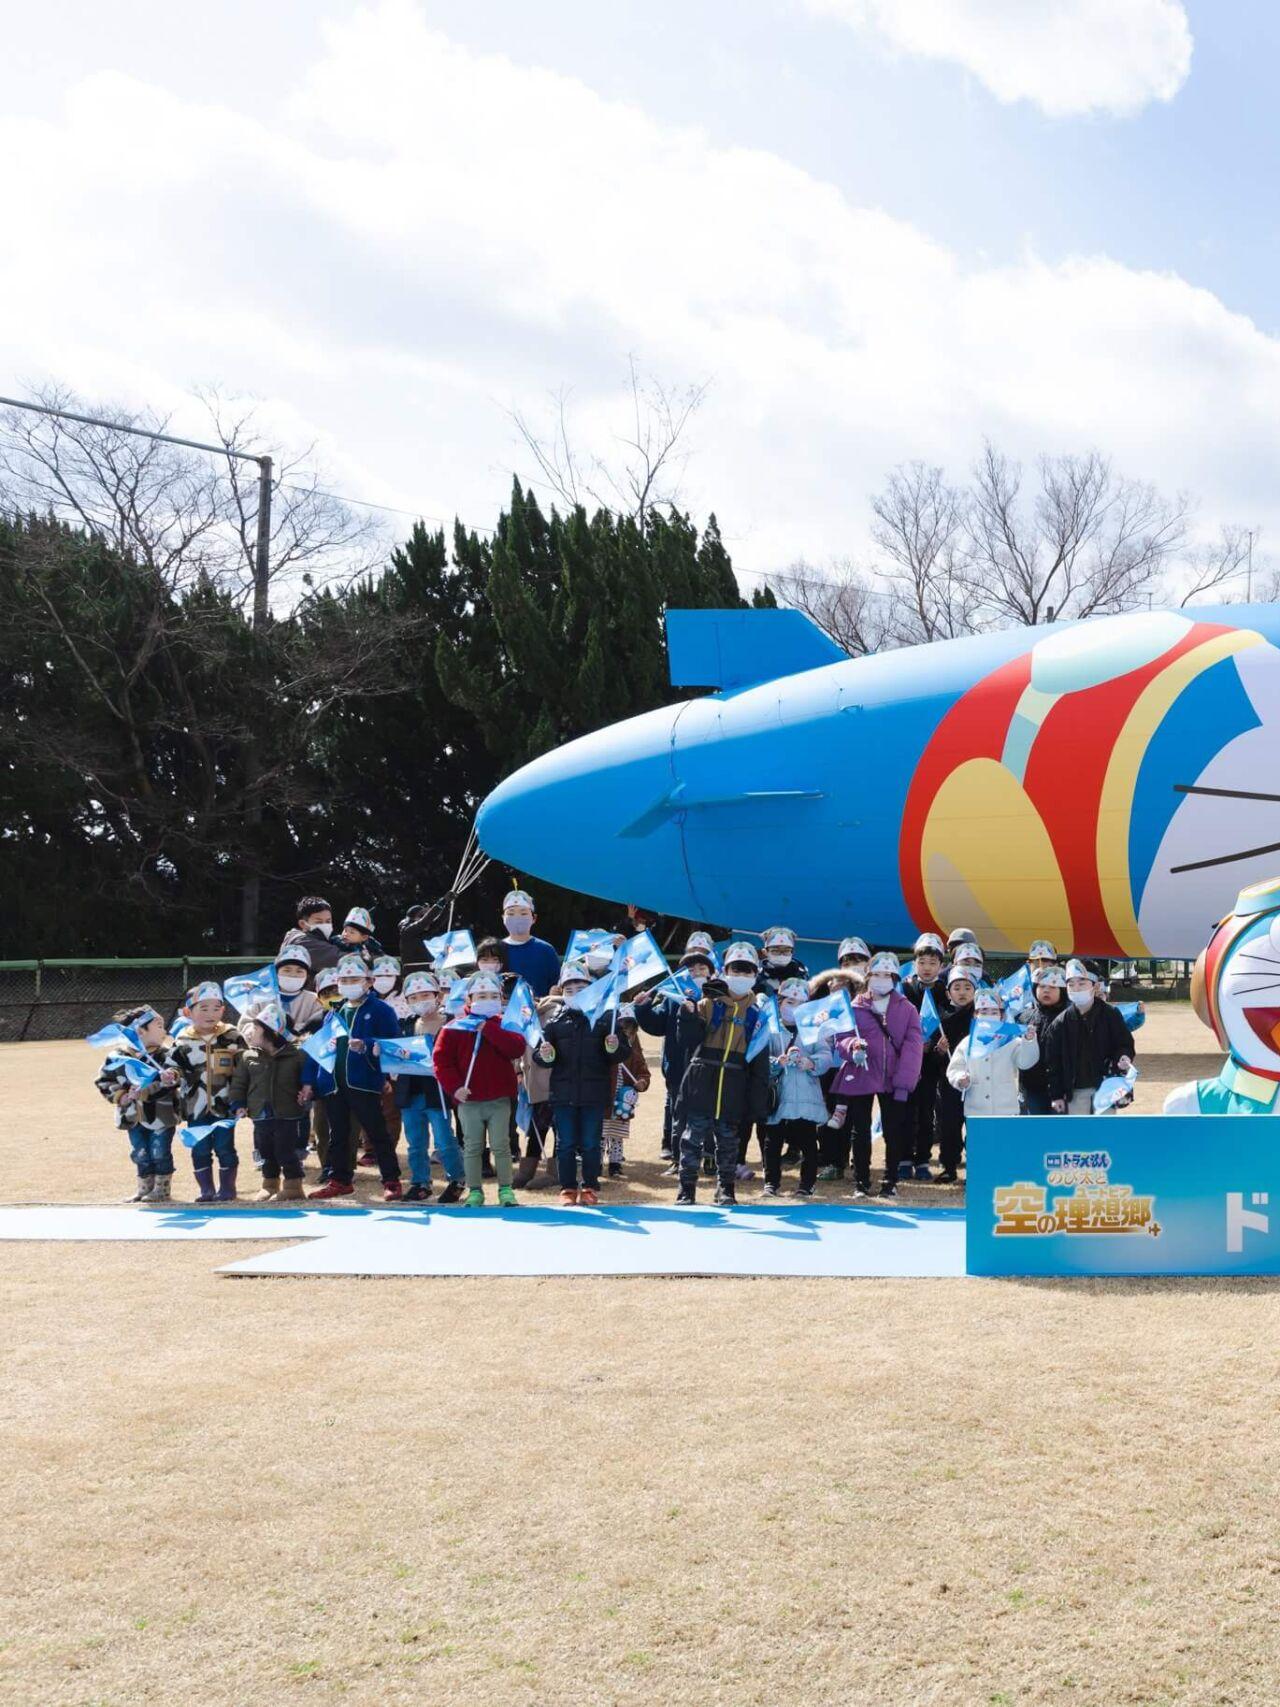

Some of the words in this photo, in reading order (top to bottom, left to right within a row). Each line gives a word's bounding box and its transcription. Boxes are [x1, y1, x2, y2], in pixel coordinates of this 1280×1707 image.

[1047, 1170, 1108, 1186] のび太と
[993, 1183, 1155, 1236] 空の理想郷
